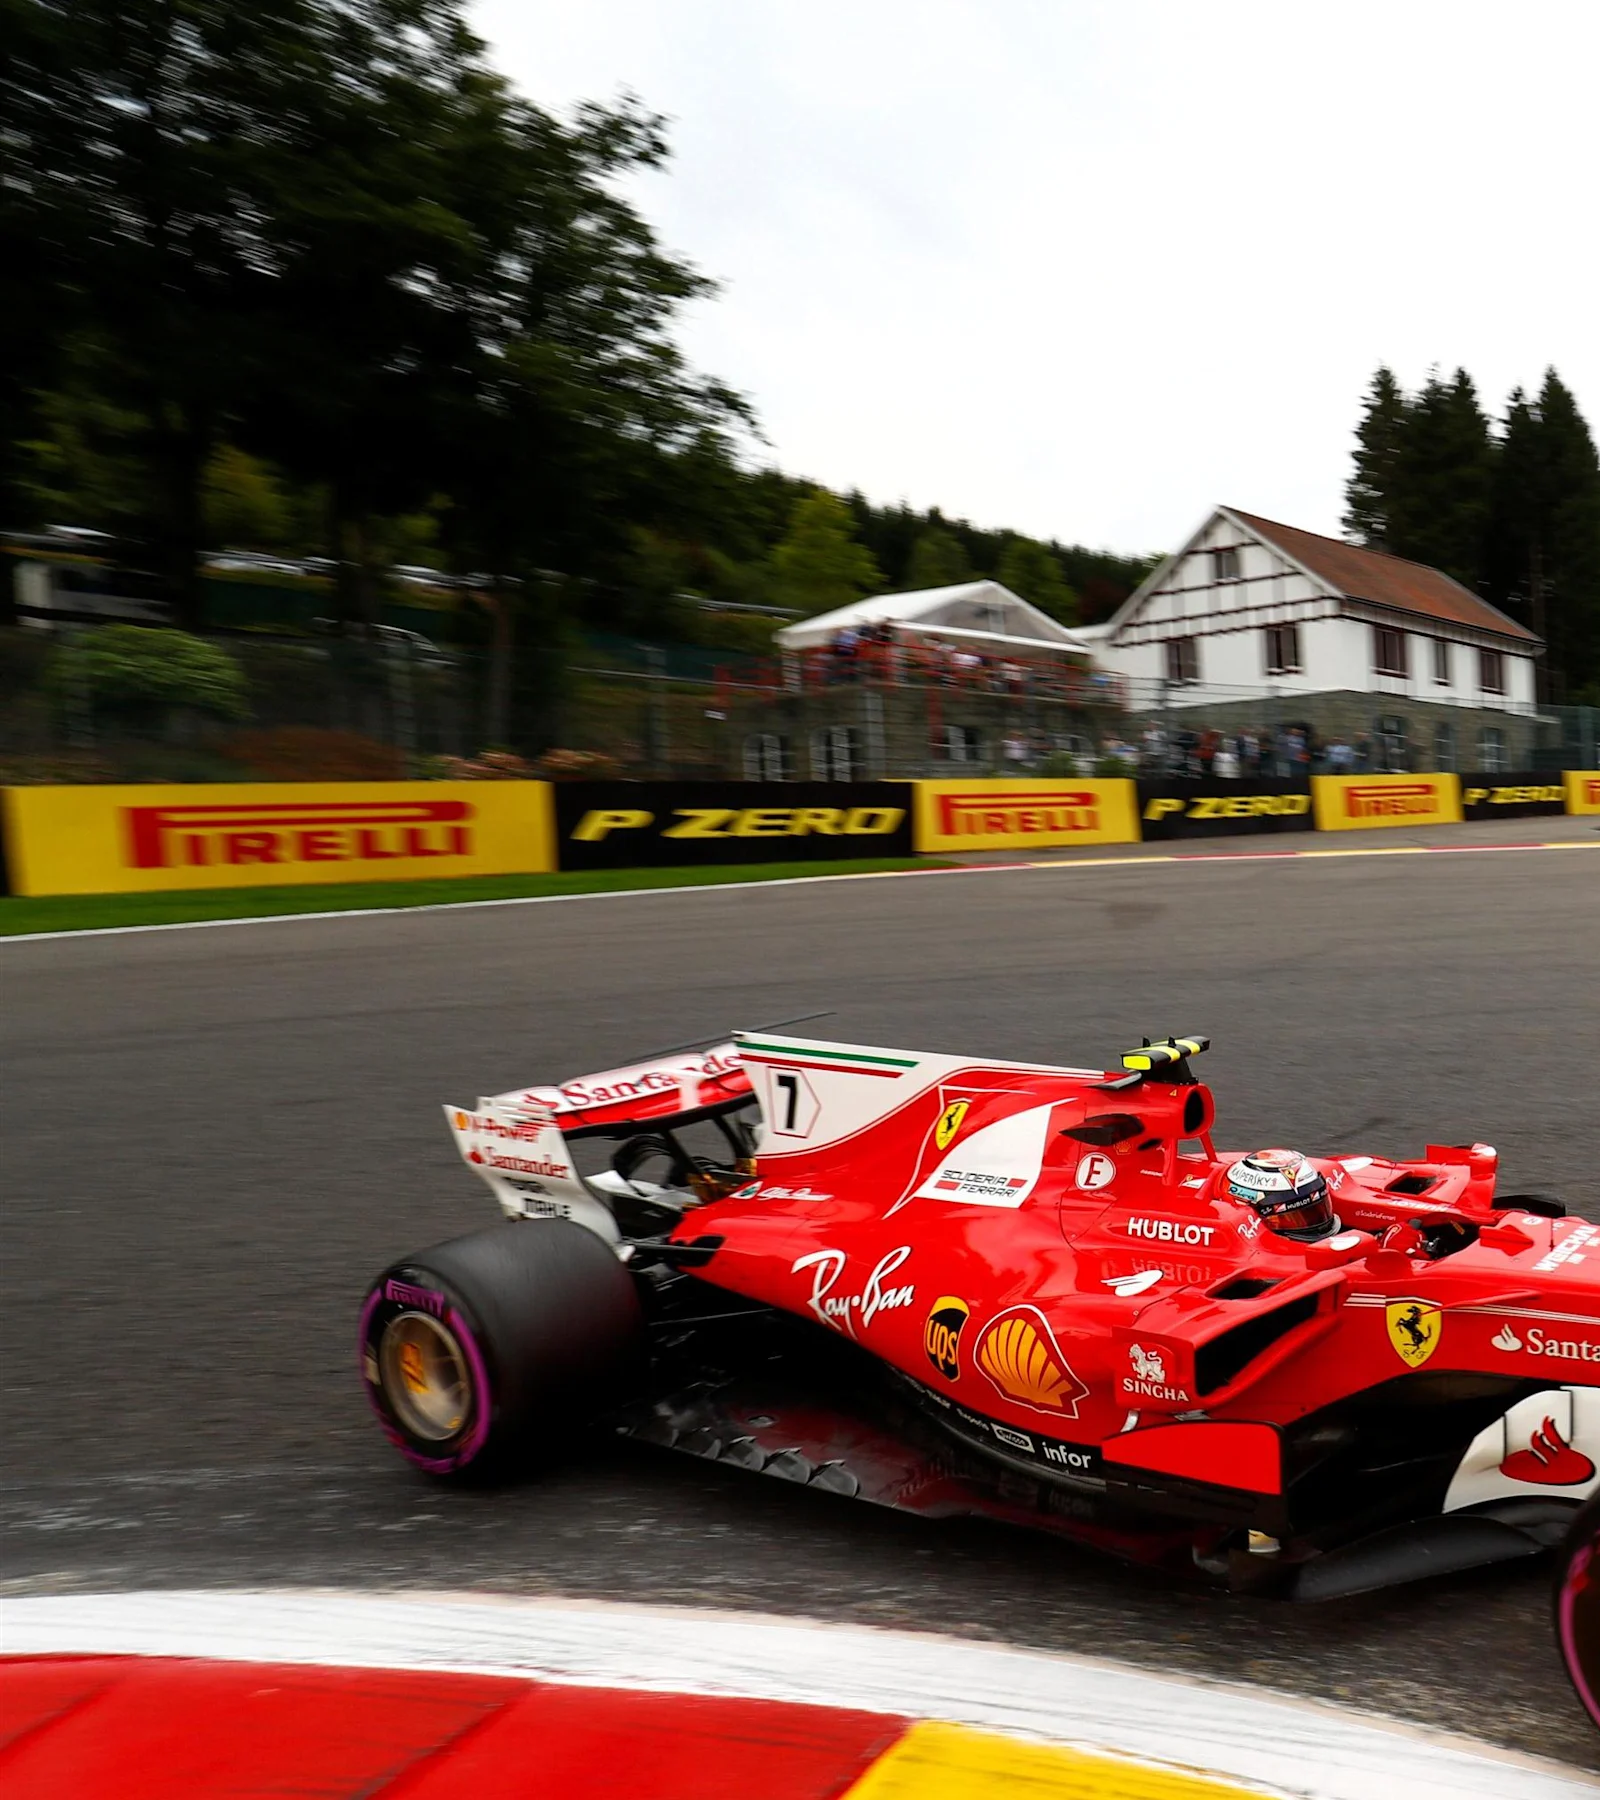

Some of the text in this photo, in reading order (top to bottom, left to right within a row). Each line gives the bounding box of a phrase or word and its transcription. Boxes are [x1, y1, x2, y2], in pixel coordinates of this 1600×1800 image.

[935, 792, 1100, 836] PIRELLI
[1143, 794, 1312, 821] P ZERO
[119, 800, 476, 869] PIRELLI
[570, 806, 906, 841] P ZERO
[776, 1073, 798, 1130] 7
[485, 1146, 570, 1179] Santander
[941, 1169, 1008, 1186] SCUDERIA
[1084, 1157, 1104, 1186] E
[1231, 1167, 1272, 1187] KASPERSKY
[959, 1184, 1019, 1197] FERRARI
[1127, 1216, 1215, 1247] HUBLOT
[926, 1319, 958, 1372] ups
[1122, 1377, 1190, 1403] SINGHA
[1042, 1441, 1092, 1469] infor
